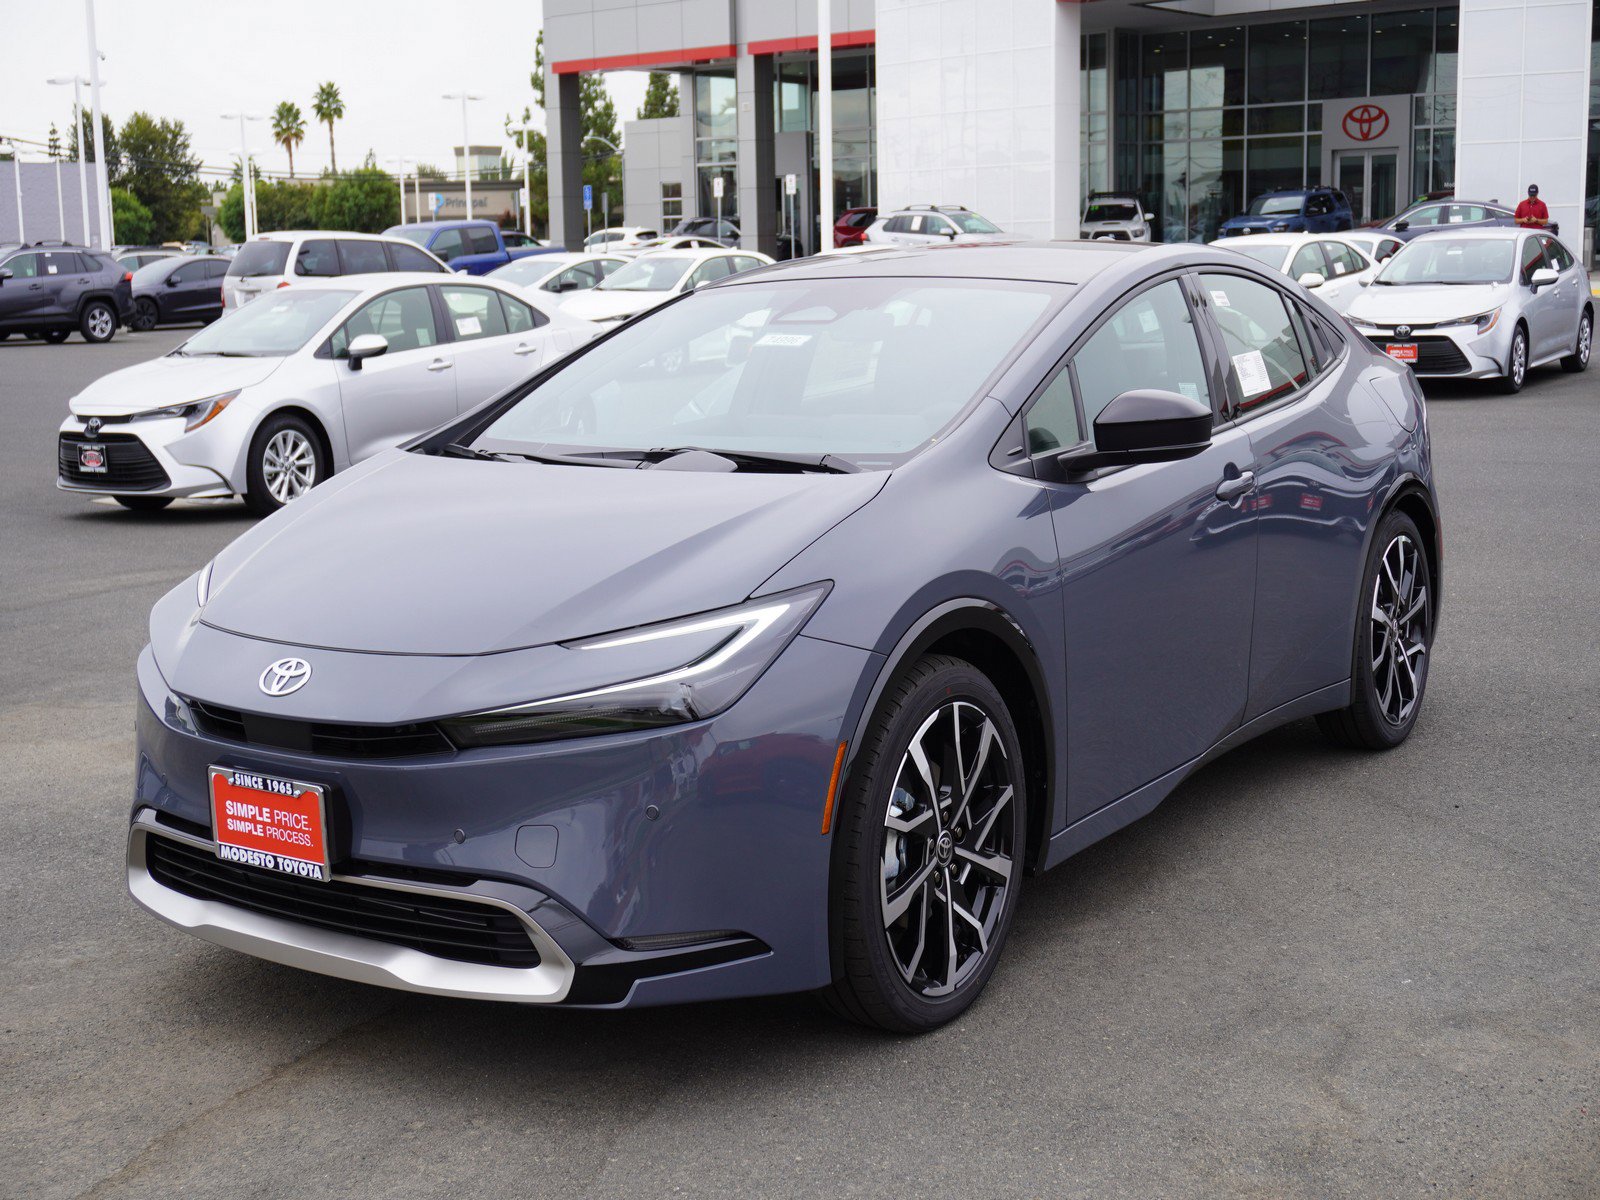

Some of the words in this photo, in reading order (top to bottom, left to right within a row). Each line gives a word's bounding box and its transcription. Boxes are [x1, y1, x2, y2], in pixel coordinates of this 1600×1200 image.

[235, 773, 264, 789] SINCE
[267, 779, 293, 795] 1965
[225, 800, 271, 822] SIMPLE
[274, 810, 312, 832] PRICE.
[227, 818, 264, 836] SIMPLE
[266, 826, 314, 847] PROCESS.
[220, 845, 275, 868] MODESTO
[277, 858, 322, 880] TOYOTA
